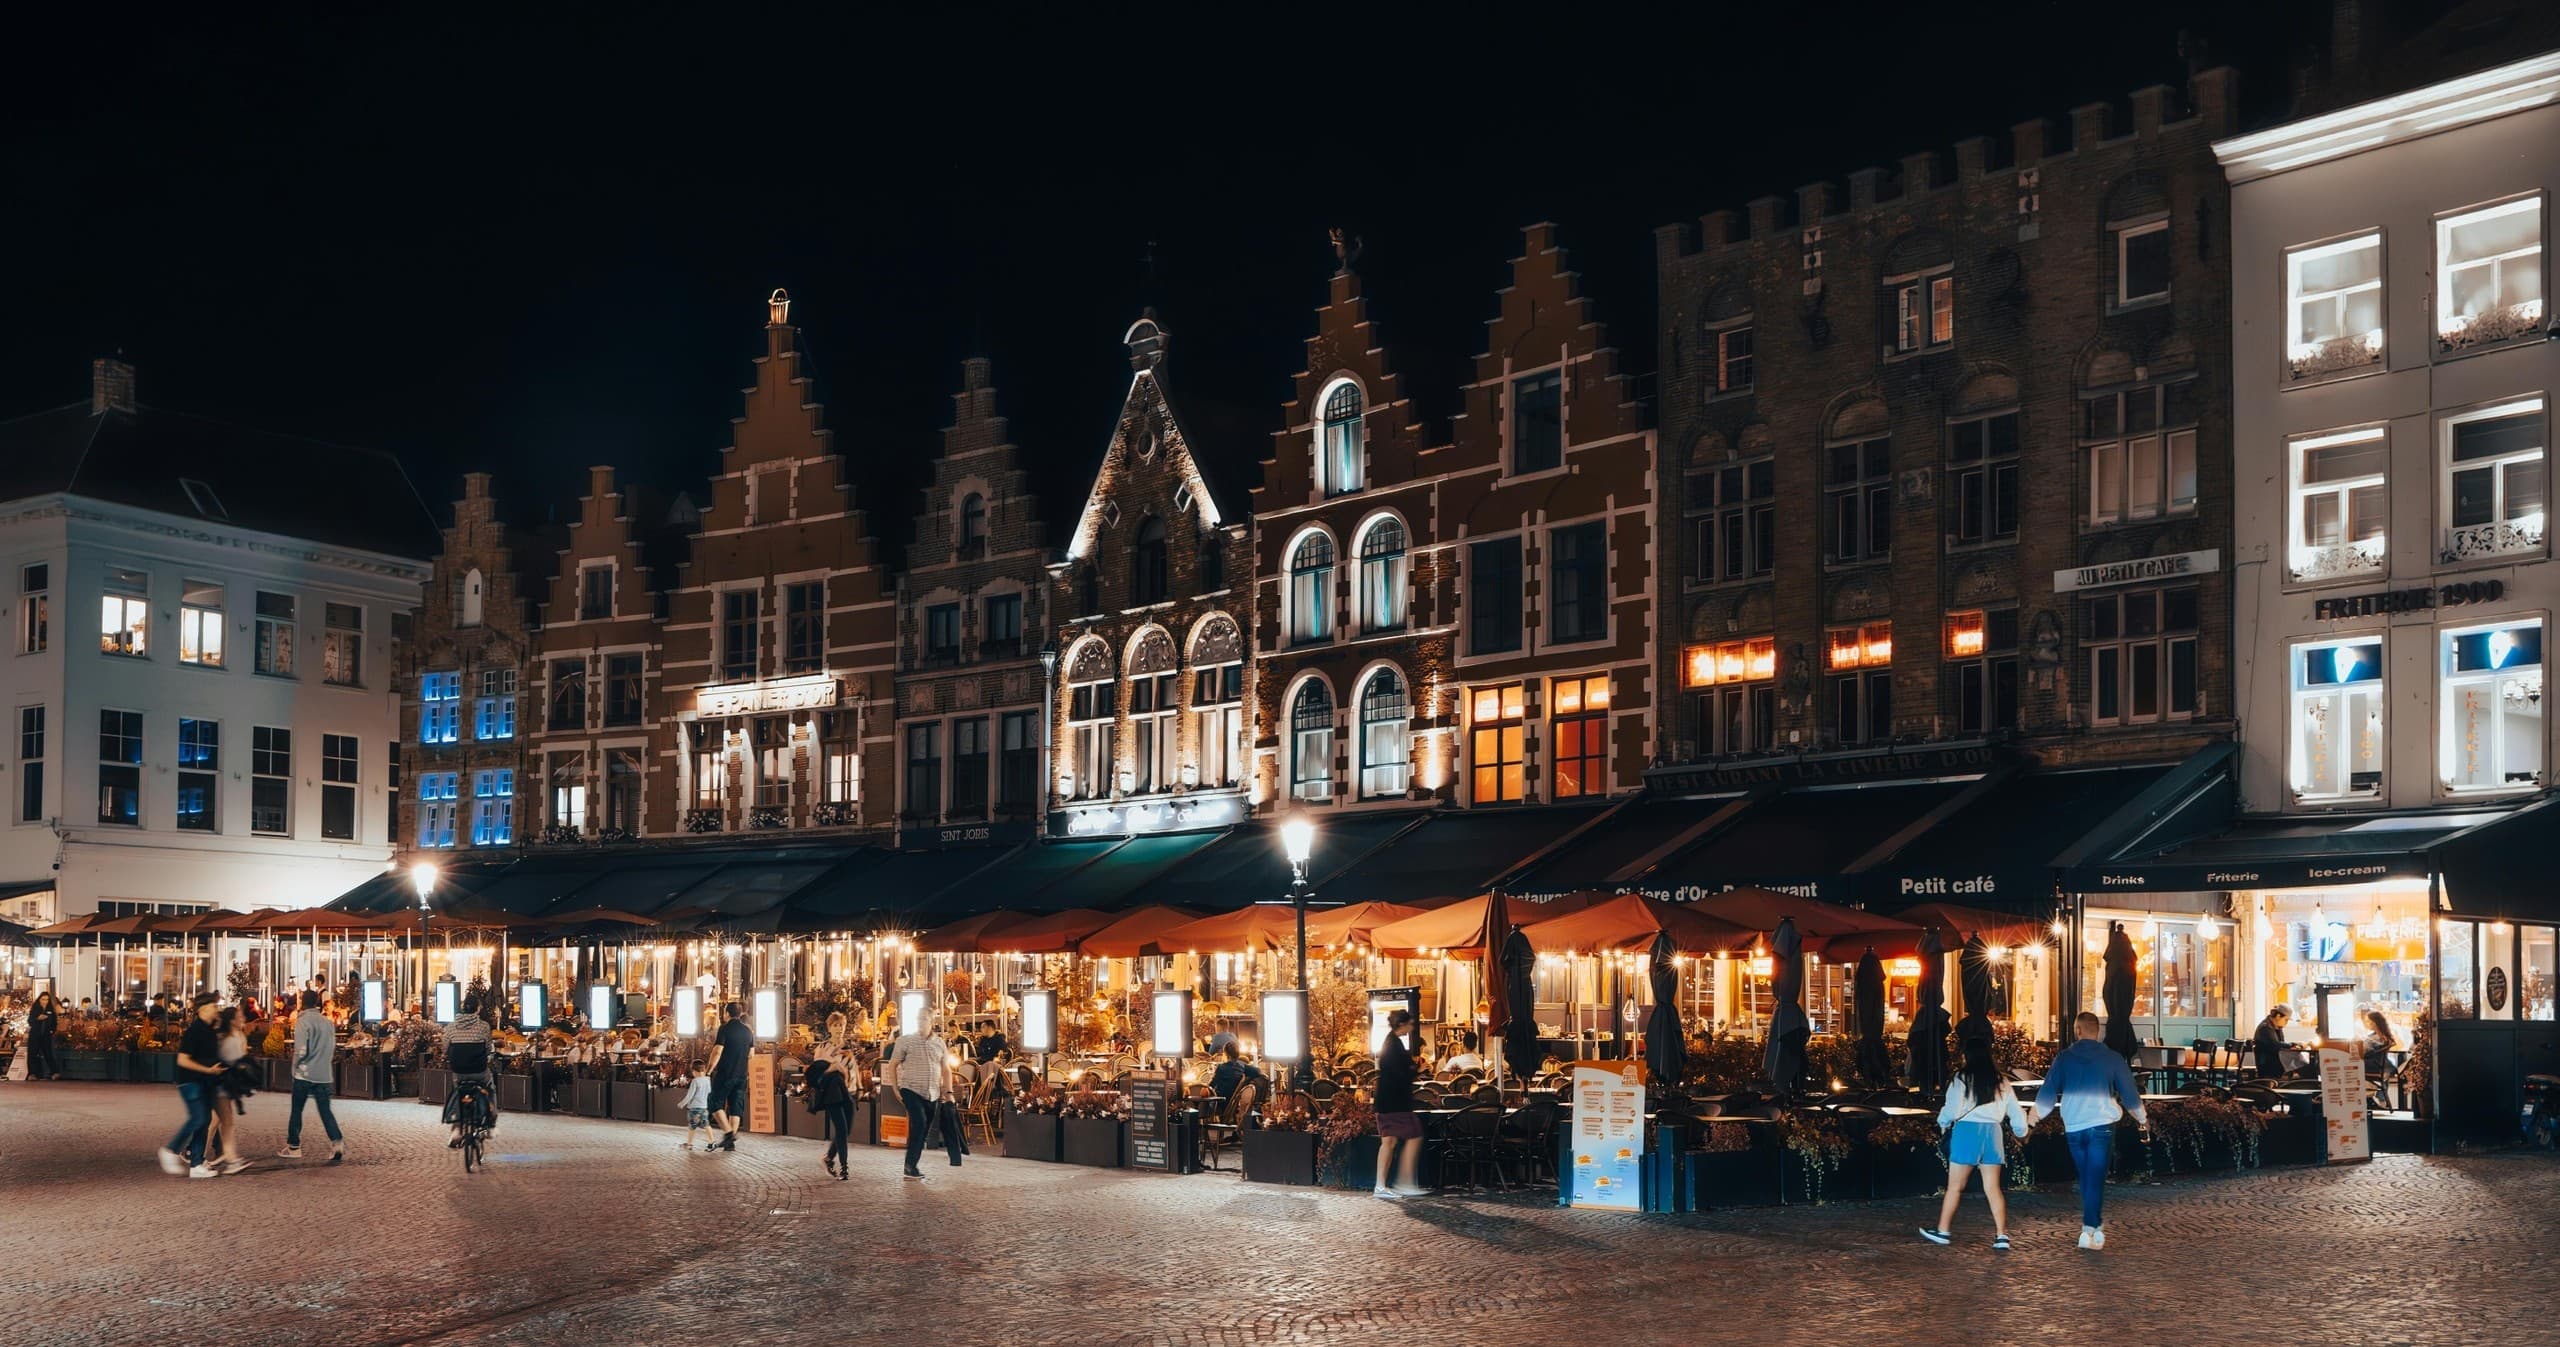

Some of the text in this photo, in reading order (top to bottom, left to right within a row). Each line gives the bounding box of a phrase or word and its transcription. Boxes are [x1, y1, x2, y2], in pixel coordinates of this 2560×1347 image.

[2077, 568, 2093, 586] AU
[2099, 562, 2139, 584] PETIT
[2315, 579, 2504, 622] FRITERIE 1900
[1651, 766, 1783, 792] RESTAURANT
[1797, 762, 1825, 780] LA
[941, 827, 990, 842] SINT JORIS
[2102, 874, 2145, 886] Drinks
[2207, 871, 2260, 884] Friterie
[2308, 863, 2387, 879] Ice-cream
[1675, 884, 1709, 902] d'Or
[1901, 874, 1996, 896] Petit café
